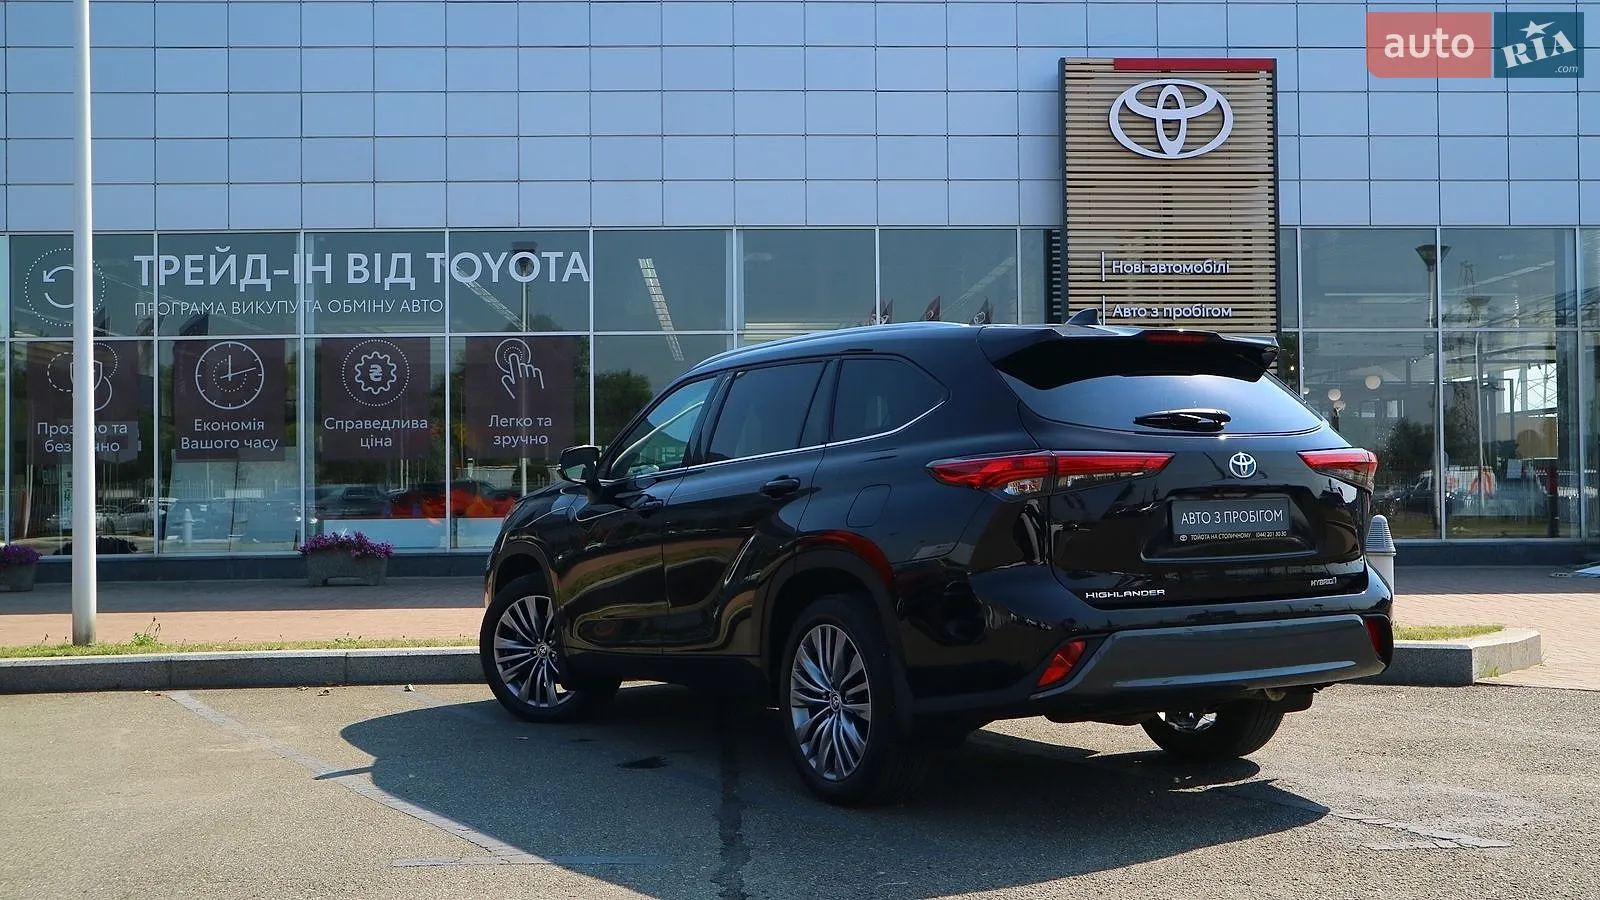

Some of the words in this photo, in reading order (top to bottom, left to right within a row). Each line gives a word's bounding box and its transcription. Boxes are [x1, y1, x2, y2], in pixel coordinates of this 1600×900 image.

[134, 246, 332, 292] ТРЕЙД-ІН
[347, 252, 415, 291] ВІД
[426, 251, 591, 283] TOYOTA
[1112, 260, 1145, 274] Нові
[1149, 259, 1230, 274] автомобілі
[135, 301, 226, 316] ПРОГРАМА
[232, 300, 300, 315] ВИКУПУ
[328, 299, 395, 314] ОБМІНУ
[400, 299, 443, 313] АВТО
[1112, 304, 1147, 318] Авто
[1150, 307, 1160, 318] з
[1163, 303, 1232, 320] пробігом
[194, 418, 265, 432] Економія
[324, 417, 428, 431] Справедлива
[489, 414, 533, 428] Легко
[537, 416, 552, 427] та
[112, 424, 128, 434] та
[181, 436, 240, 450] Вашого
[244, 438, 279, 451] часу
[360, 435, 393, 449] ціна
[493, 434, 549, 448] зручно
[1181, 511, 1212, 525] АВТО
[1224, 509, 1284, 524] ПРОБІГОМ
[1085, 589, 1166, 599] HIGHLANDER
